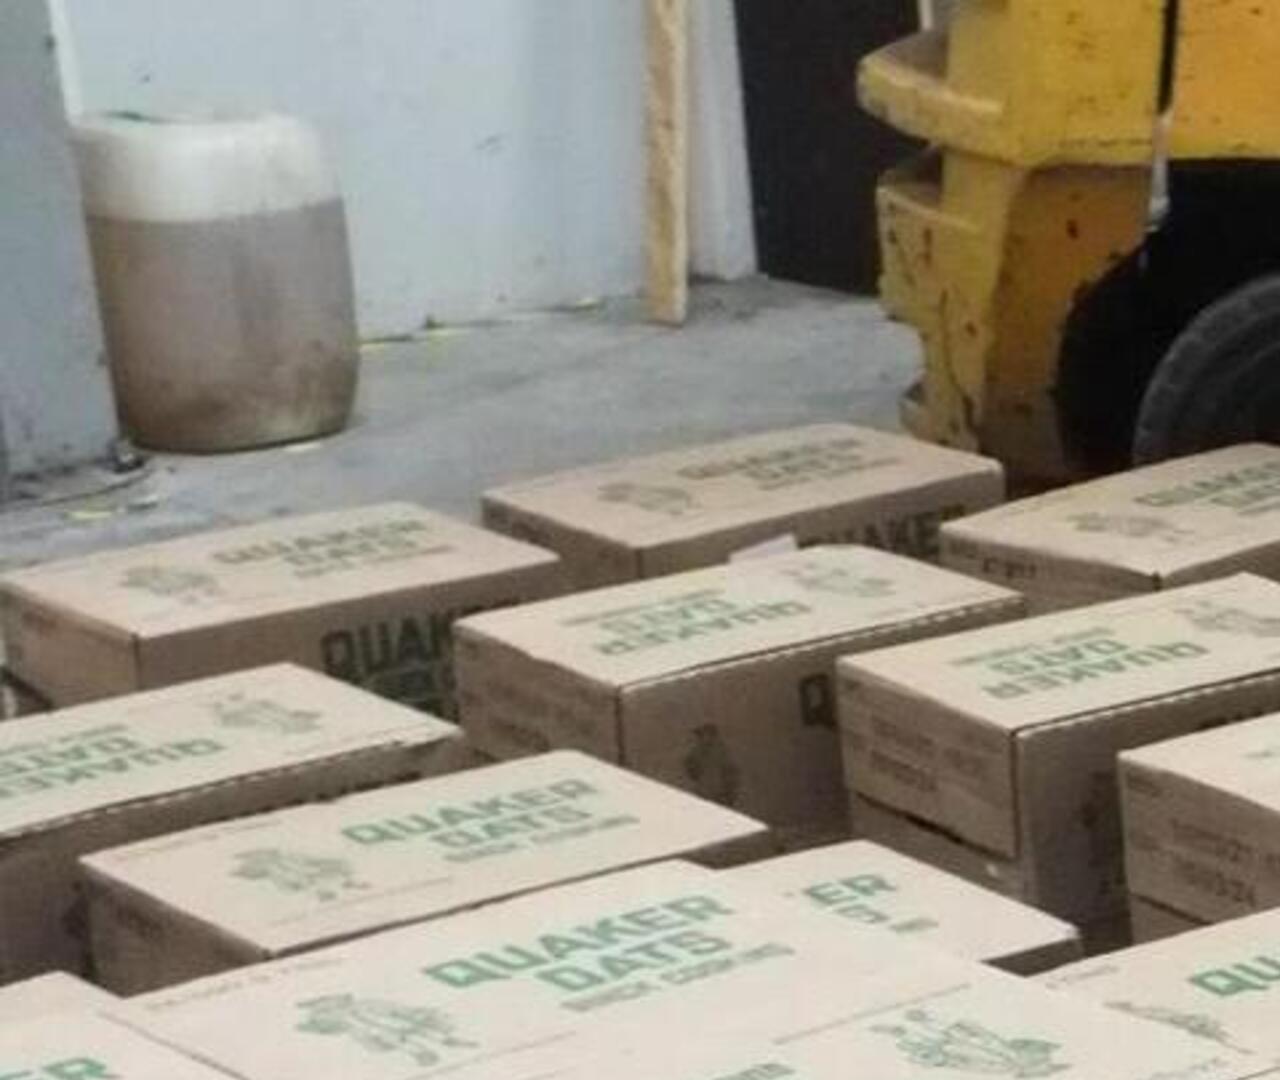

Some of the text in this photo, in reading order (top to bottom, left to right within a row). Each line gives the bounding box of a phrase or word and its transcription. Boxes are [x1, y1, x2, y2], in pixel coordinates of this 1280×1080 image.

[342, 777, 598, 847] QUAKER
[422, 894, 735, 990] QUAKER
[532, 930, 735, 993] OATS
